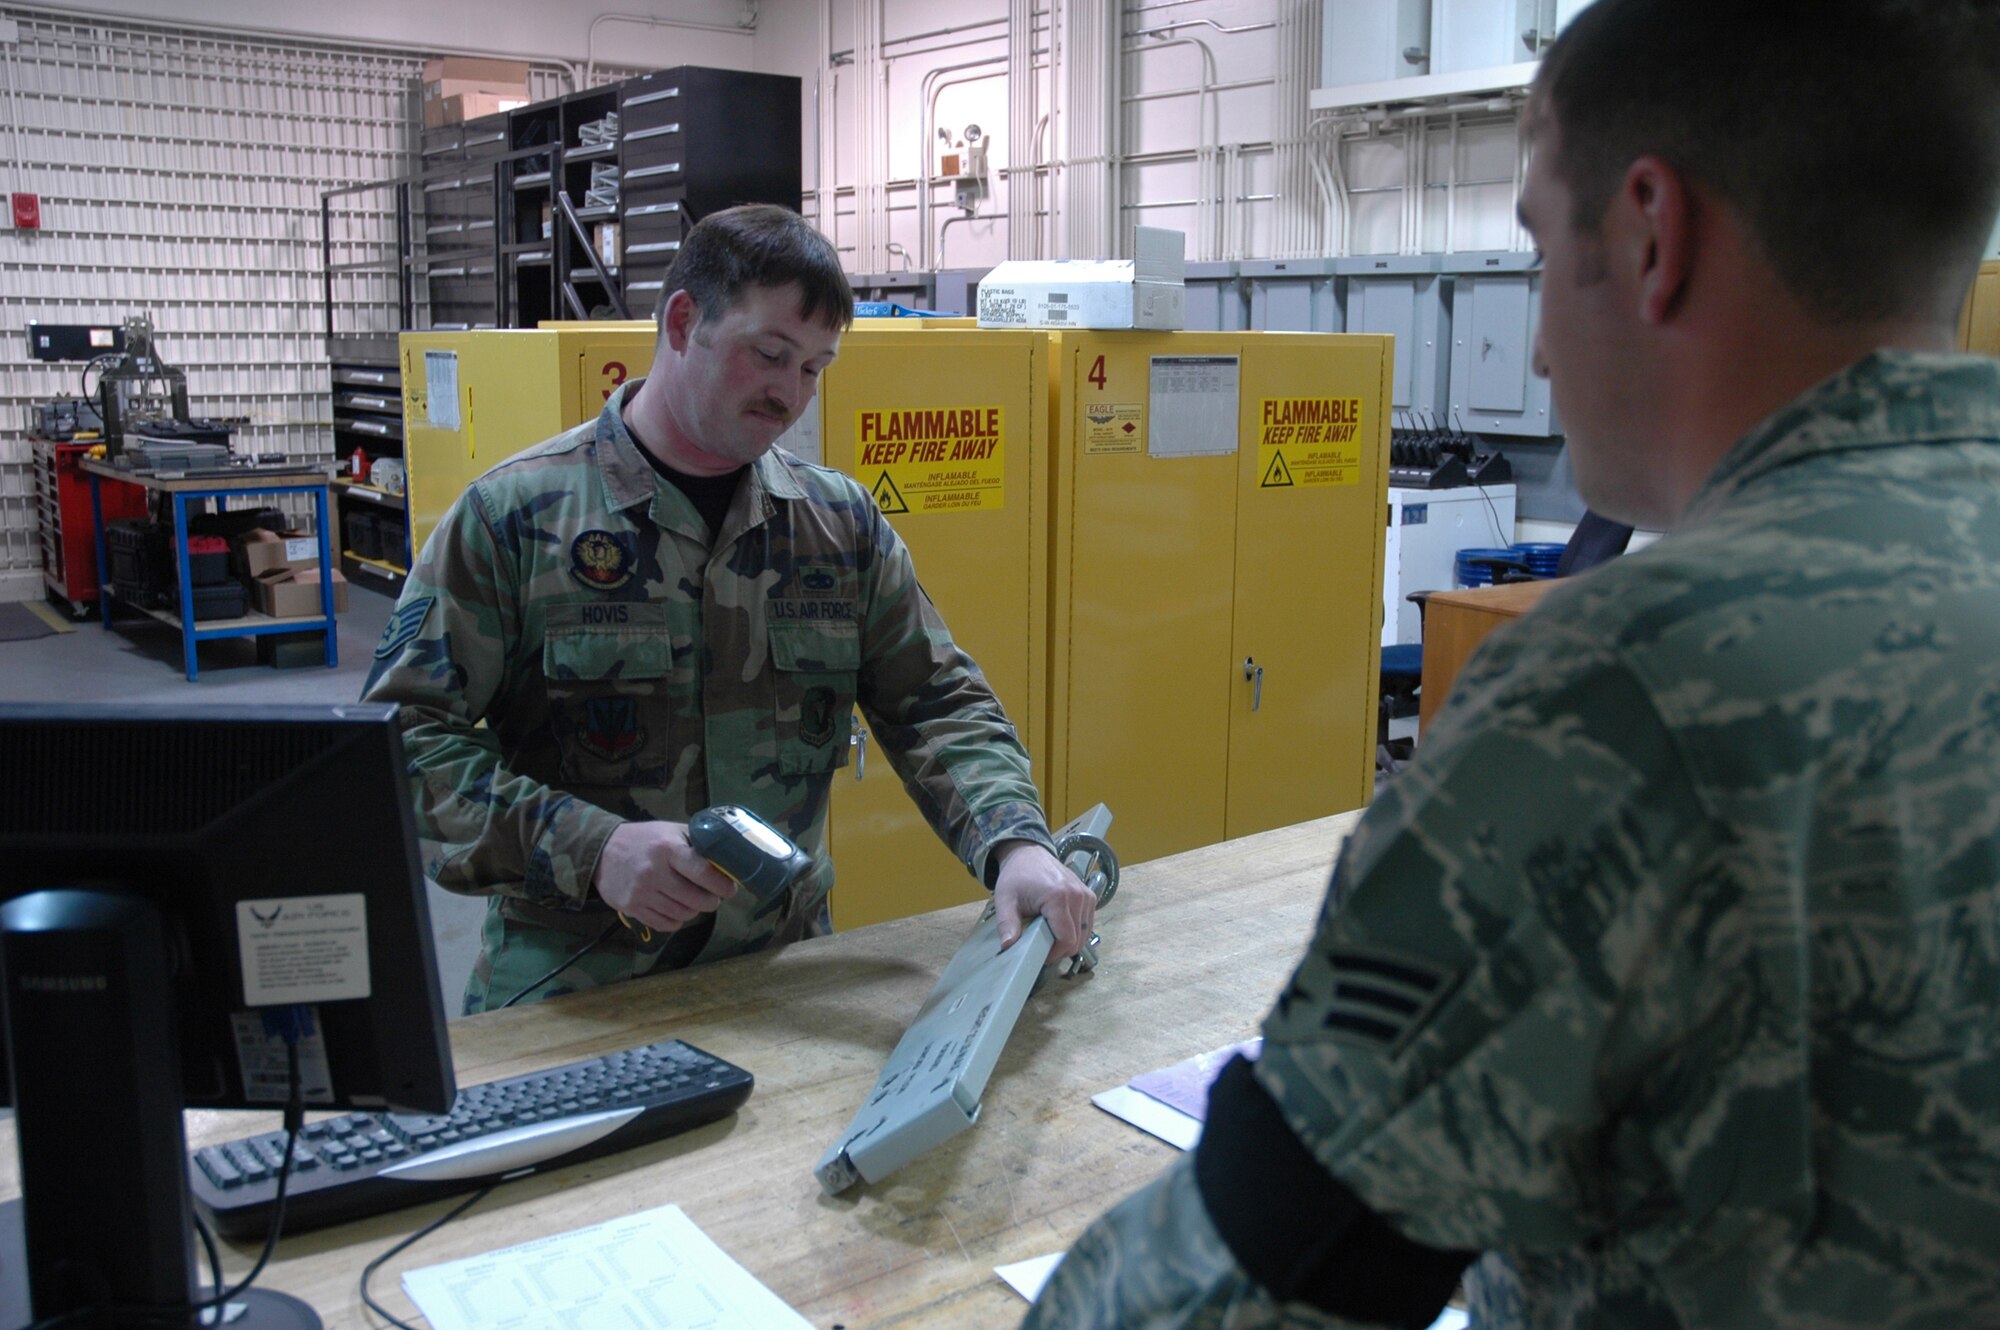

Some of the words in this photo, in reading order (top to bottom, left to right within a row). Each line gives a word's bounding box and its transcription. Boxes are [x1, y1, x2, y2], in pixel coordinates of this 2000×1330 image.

[1088, 355, 1107, 390] 4
[1089, 405, 1114, 414] EAGLE
[1263, 399, 1358, 425] FLAMMABLE
[861, 408, 999, 442] FLAMMABLE
[1263, 426, 1294, 445] KEEP
[1295, 425, 1323, 444] FIRE
[1323, 424, 1357, 443] AWAY
[861, 442, 907, 465] KEEP
[909, 440, 948, 463] FIRE
[949, 438, 998, 461] AWAY
[928, 471, 977, 481] INFLAMABLE
[943, 479, 969, 488] ALEJADO
[981, 477, 1001, 485] FUEGO
[923, 502, 947, 510] GARDER
[947, 501, 961, 509] LOIN
[961, 500, 970, 508] DU
[970, 499, 982, 507] FEU
[925, 492, 980, 503] INFLAMMABLE
[582, 604, 629, 624] HOVIS
[799, 600, 819, 618] AIR
[820, 600, 852, 619] FORCE
[21, 976, 107, 991] SAMSUNG
